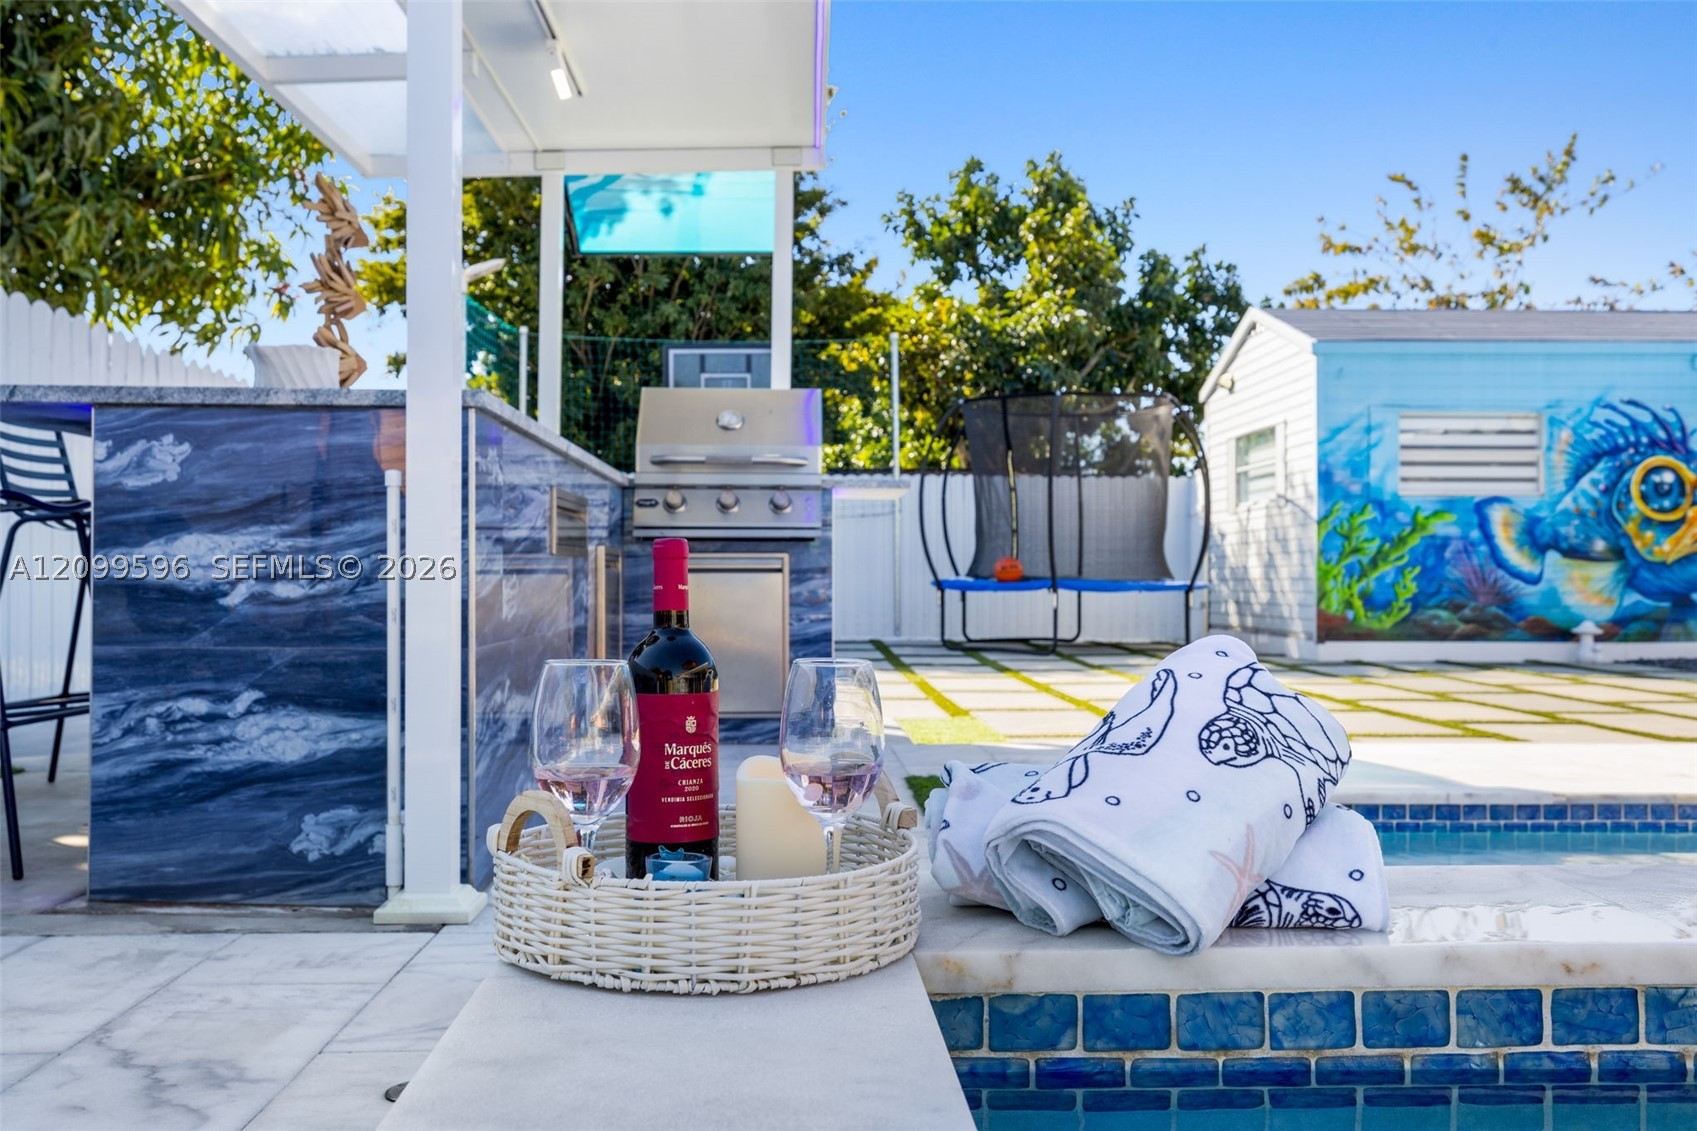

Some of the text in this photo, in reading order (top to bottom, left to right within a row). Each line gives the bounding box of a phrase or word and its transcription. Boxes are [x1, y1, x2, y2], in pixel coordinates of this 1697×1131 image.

[664, 742, 711, 757] Marqués
[664, 757, 711, 769] DE Cáceres
